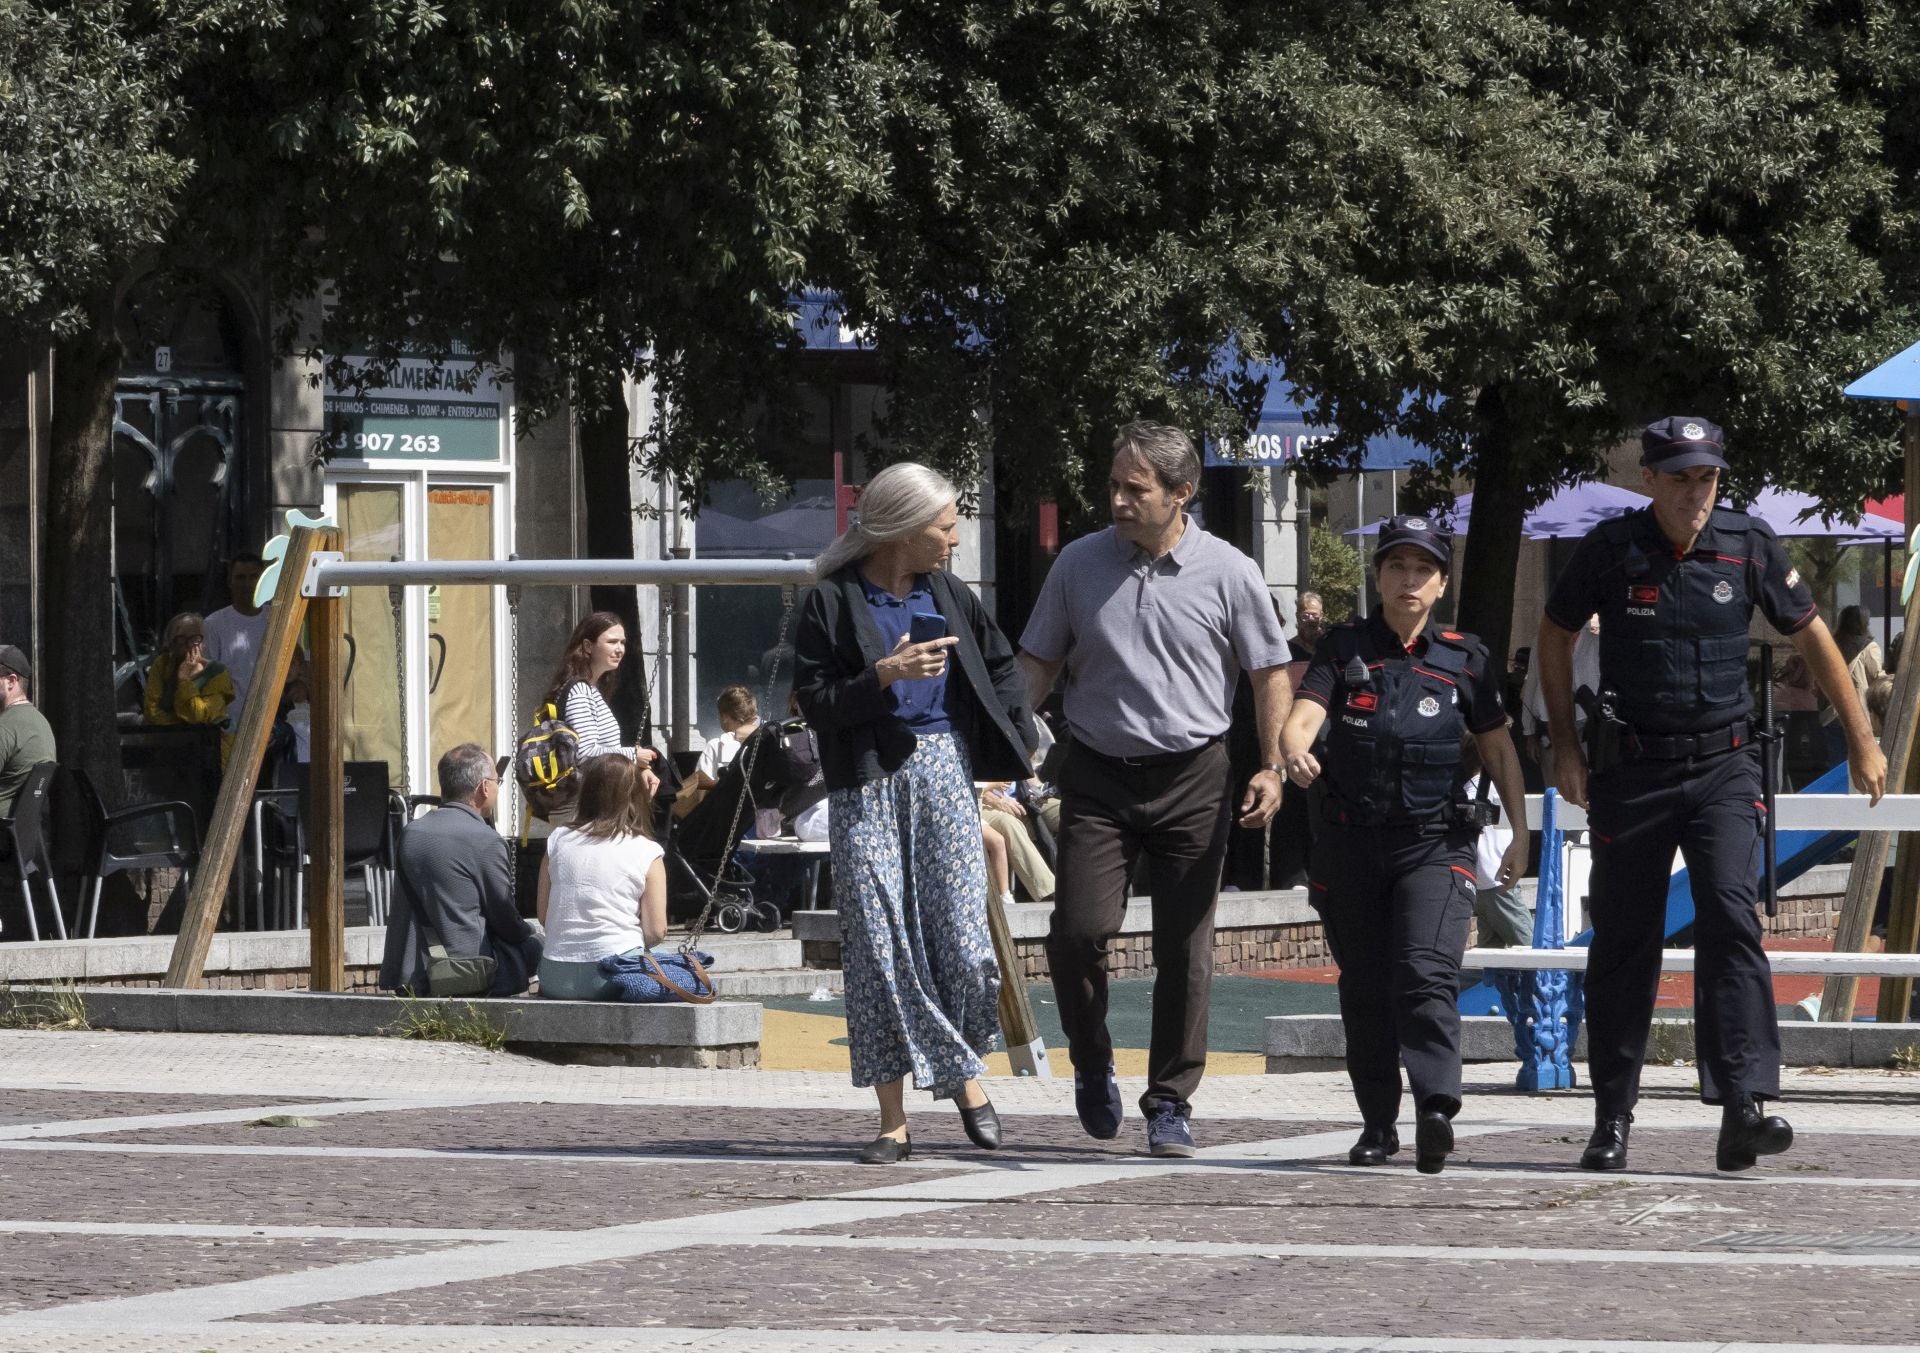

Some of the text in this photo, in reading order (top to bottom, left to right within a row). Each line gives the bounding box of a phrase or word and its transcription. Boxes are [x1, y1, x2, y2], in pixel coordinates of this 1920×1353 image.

[158, 352, 168, 368] 27
[335, 401, 364, 413] HUMOS
[370, 402, 410, 416] CHIMENEA
[447, 405, 498, 418] ENTREPLANTA
[353, 432, 394, 451] 907
[400, 434, 441, 452] 263
[1626, 607, 1656, 616] POLIZIA
[1342, 714, 1368, 728] POLIZIA
